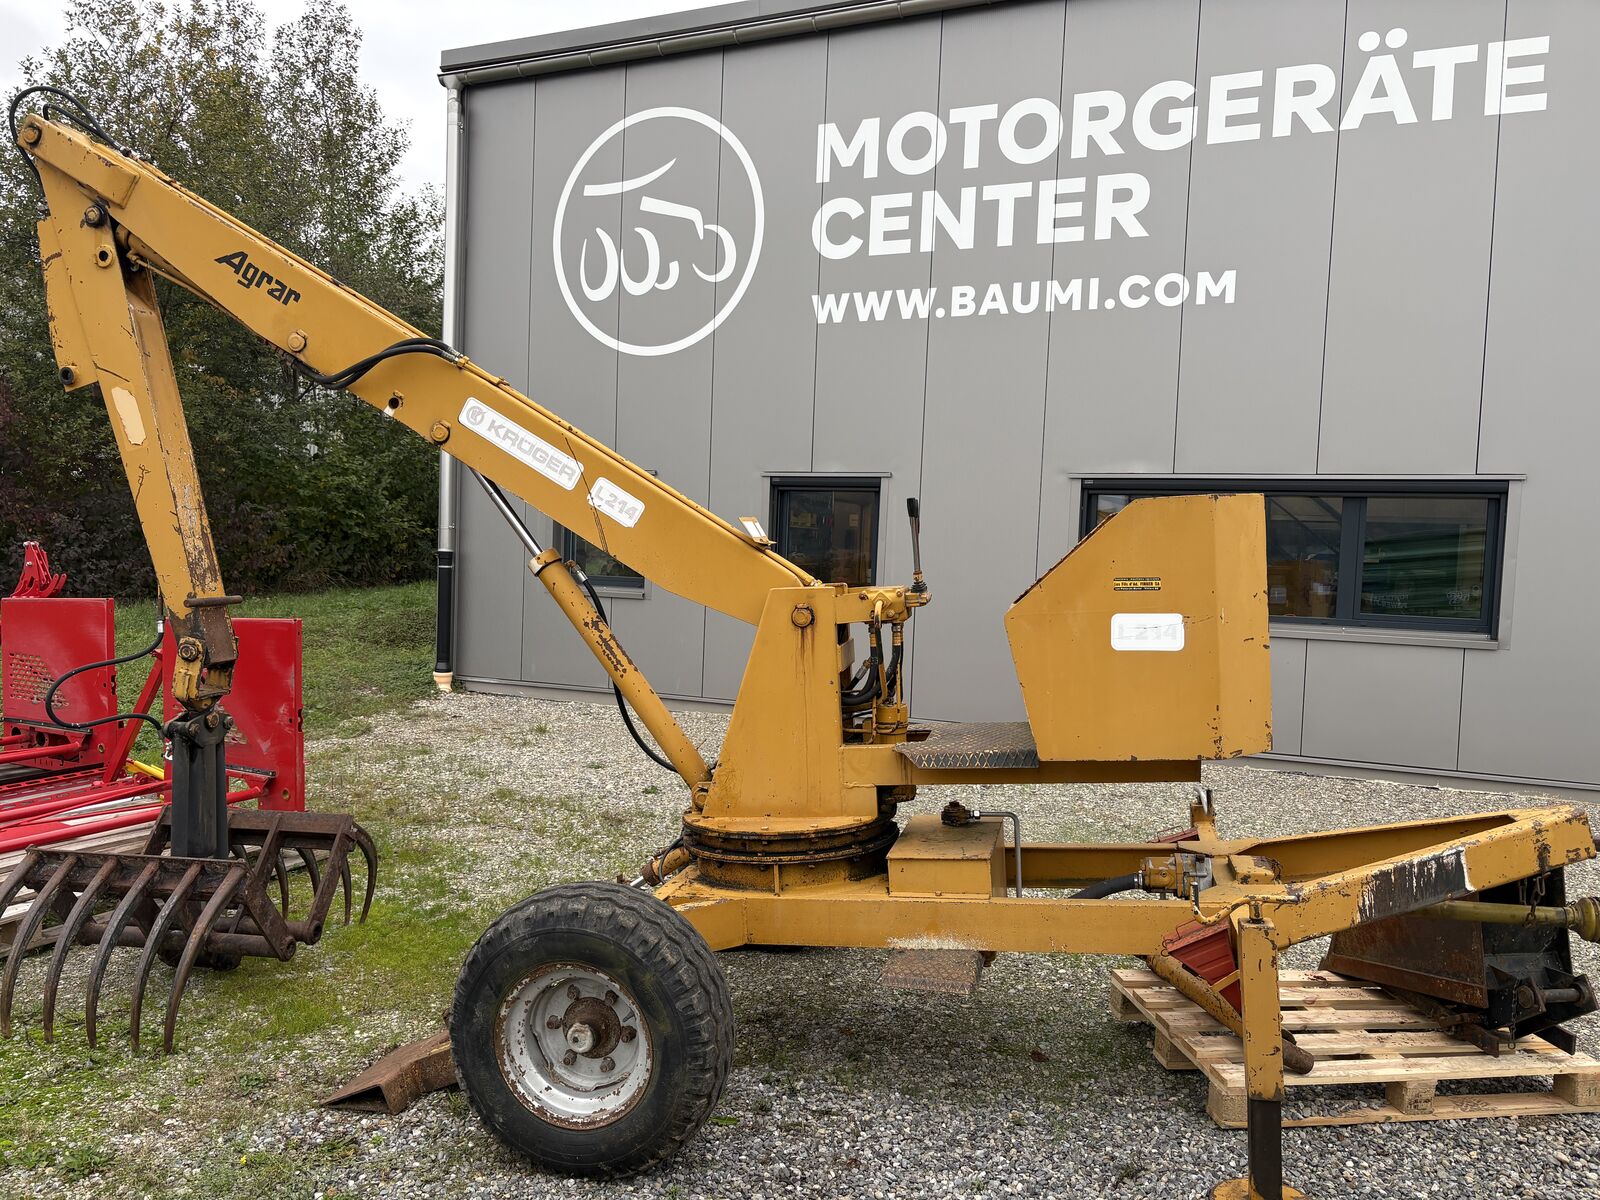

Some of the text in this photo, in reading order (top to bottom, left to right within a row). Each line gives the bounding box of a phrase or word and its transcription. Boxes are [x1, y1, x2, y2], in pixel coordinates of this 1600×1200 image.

[815, 27, 1551, 184] MOTORGERÄTE
[811, 172, 1151, 260] CENTER
[213, 251, 301, 306] Agrar
[811, 269, 1237, 326] WWW.BAUMI.COM
[487, 419, 577, 480] KRÜGER
[594, 485, 638, 520] L214
